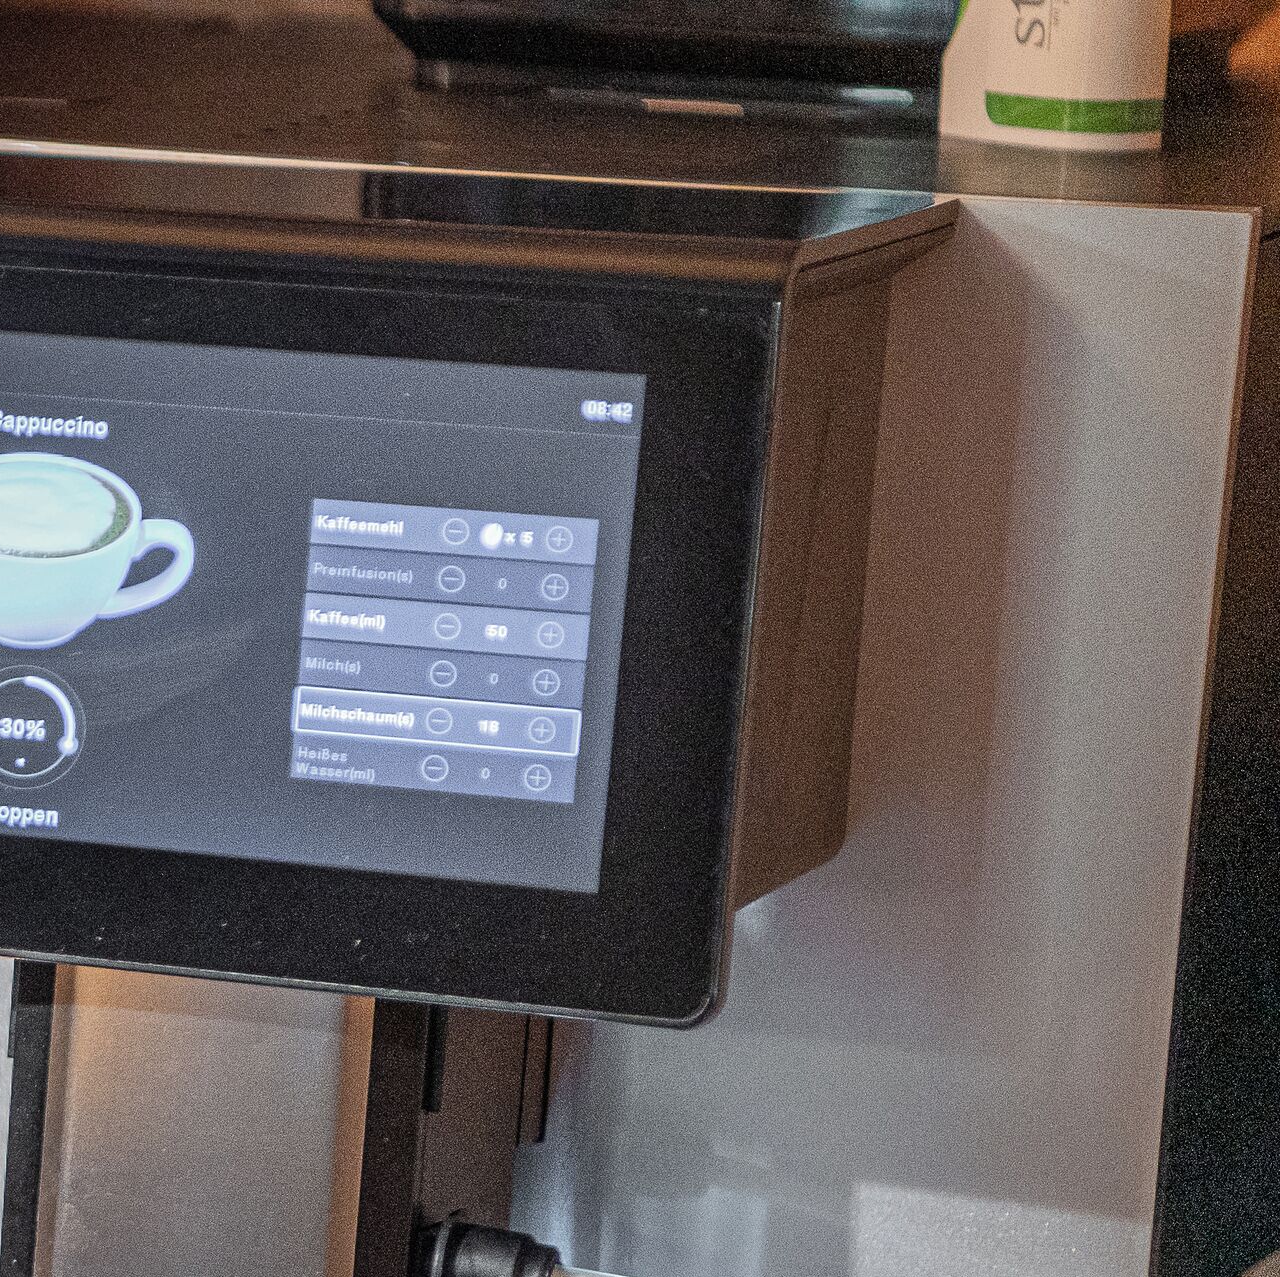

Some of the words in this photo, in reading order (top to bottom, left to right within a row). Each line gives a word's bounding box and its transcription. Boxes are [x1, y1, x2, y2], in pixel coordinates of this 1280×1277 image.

[314, 514, 405, 537] Kaffeemehl
[313, 562, 413, 585] Preinfusion(s)
[307, 608, 386, 632] Kaffee(ml)
[305, 656, 361, 675] Milch(s)
[300, 702, 415, 728] Milchschaum(s)
[295, 762, 376, 783] Wasser(ml)
